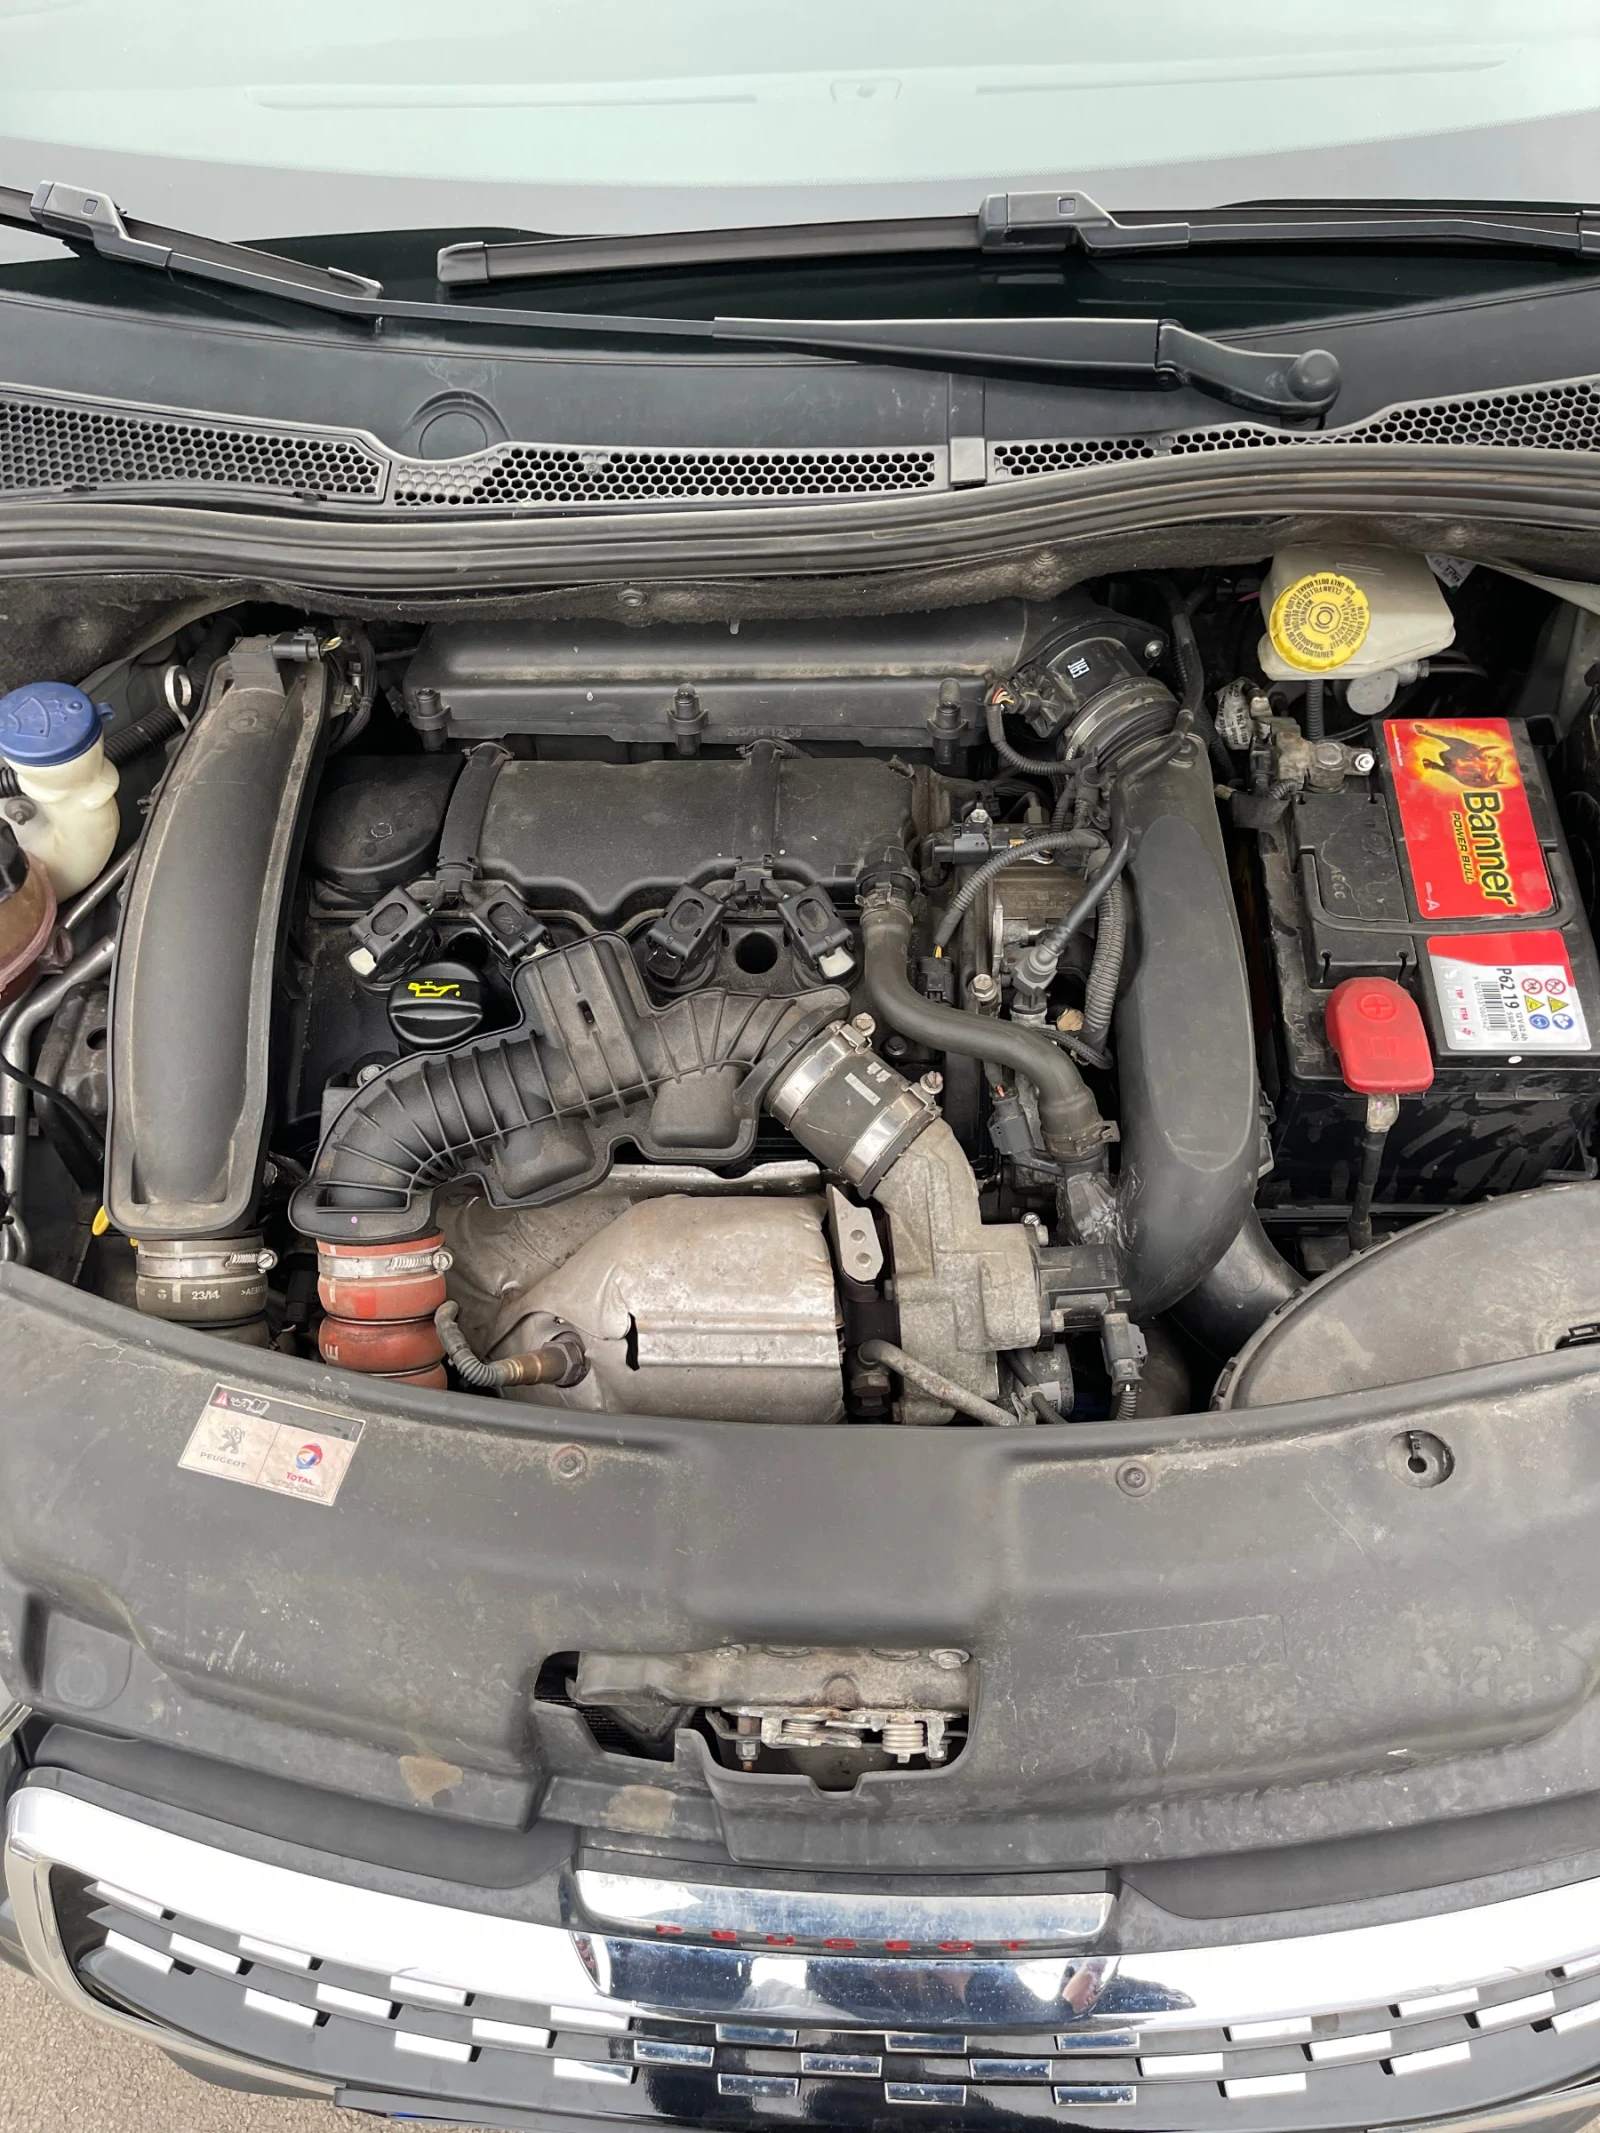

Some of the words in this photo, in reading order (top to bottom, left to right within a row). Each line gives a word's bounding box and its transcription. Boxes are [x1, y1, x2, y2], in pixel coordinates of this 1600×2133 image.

[1296, 580, 1314, 595] BRAKE
[1315, 578, 1329, 586] DOT4
[1330, 579, 1344, 588] ONLY
[1304, 586, 1322, 600] FILLER
[1324, 586, 1342, 596] CLEAN
[1344, 585, 1355, 596] USE
[1286, 594, 1299, 609] FLUID
[1296, 598, 1304, 610] CAP
[1300, 599, 1314, 626] WARNING
[1291, 610, 1301, 633] BEFORE
[1287, 632, 1303, 651] SEALED
[1296, 632, 1324, 650] REMOVING
[1303, 647, 1334, 658] CONTAINER
[1451, 812, 1468, 852] POWER
[1461, 855, 1474, 884] BULL
[1463, 791, 1513, 905] Banner
[1496, 968, 1516, 991] P62
[1503, 995, 1520, 1010] 19
[1506, 1011, 1514, 1024] 550
[1509, 1029, 1519, 1042] (EN)
[1520, 1032, 1528, 1042] Ah
[191, 1289, 221, 1301] 23/14
[199, 1451, 248, 1469] PEUGEOT
[286, 1472, 315, 1486] TOTAL
[655, 1924, 1030, 1952] PEUGEOT
